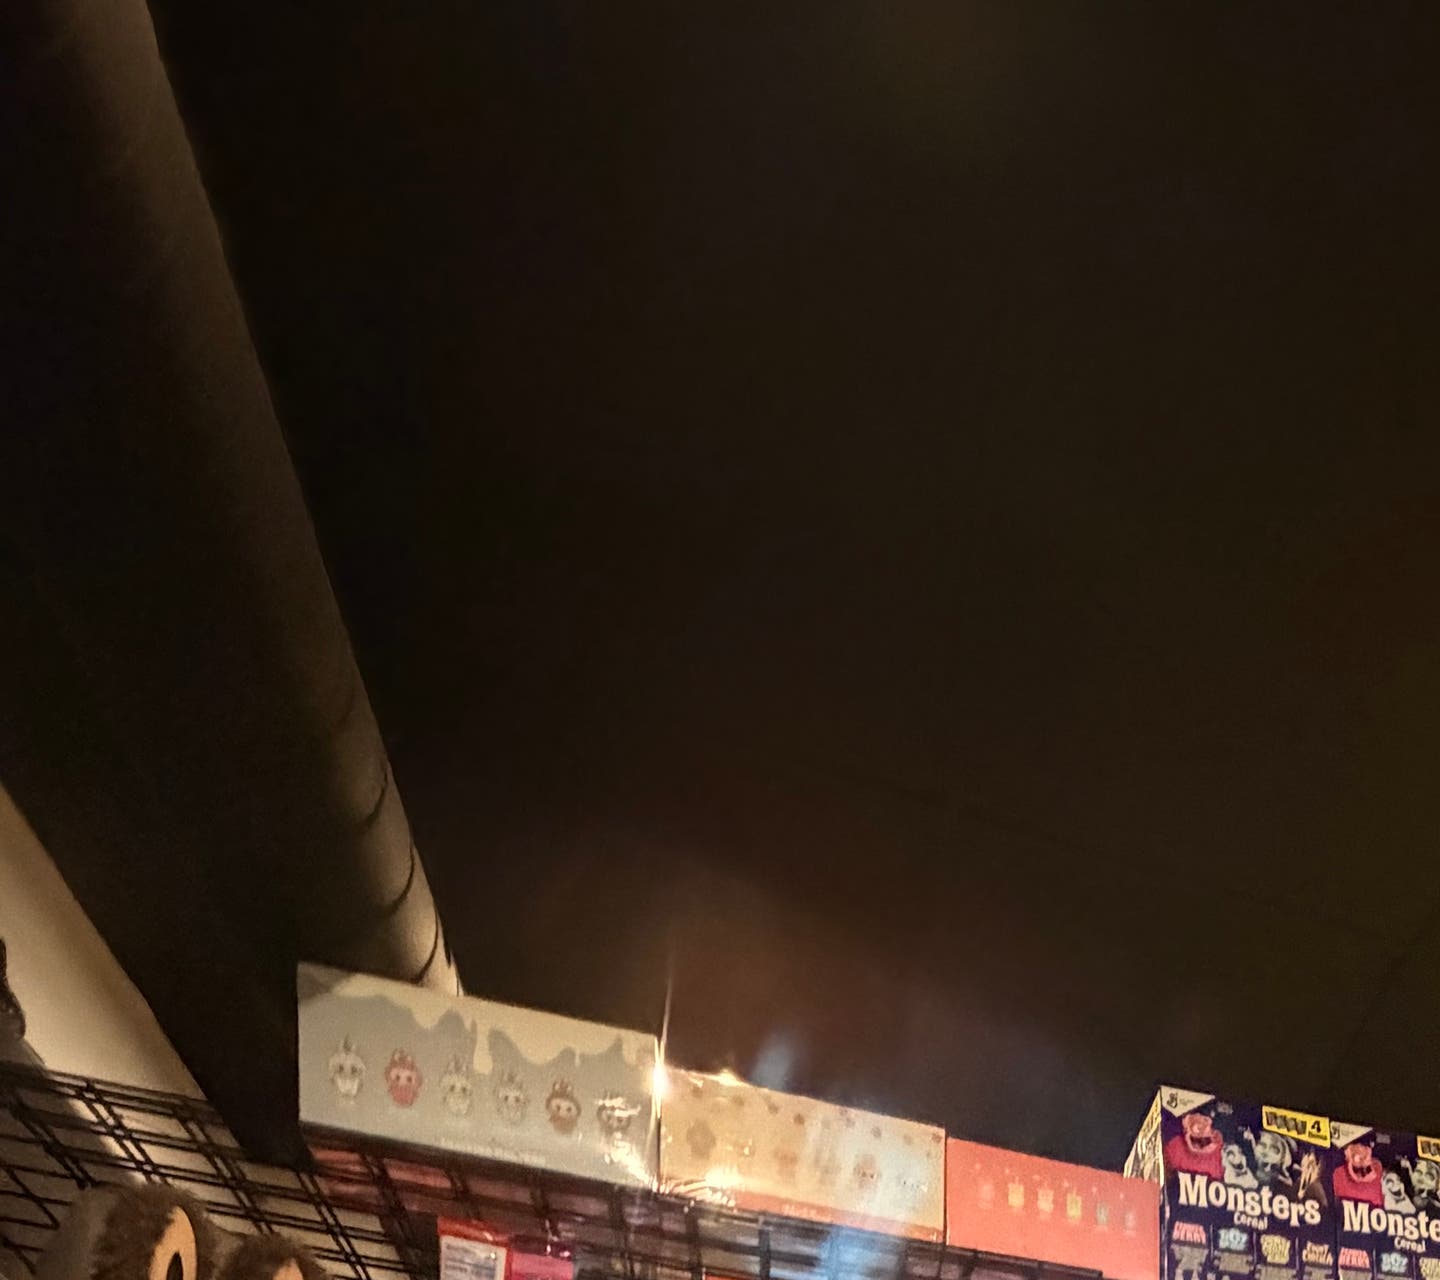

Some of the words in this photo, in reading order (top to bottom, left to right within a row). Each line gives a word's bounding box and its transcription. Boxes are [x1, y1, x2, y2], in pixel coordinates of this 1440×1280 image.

[1178, 1171, 1322, 1228] Monsters
[1233, 1211, 1269, 1231] Cereal
[1394, 1236, 1426, 1254] Cereal
